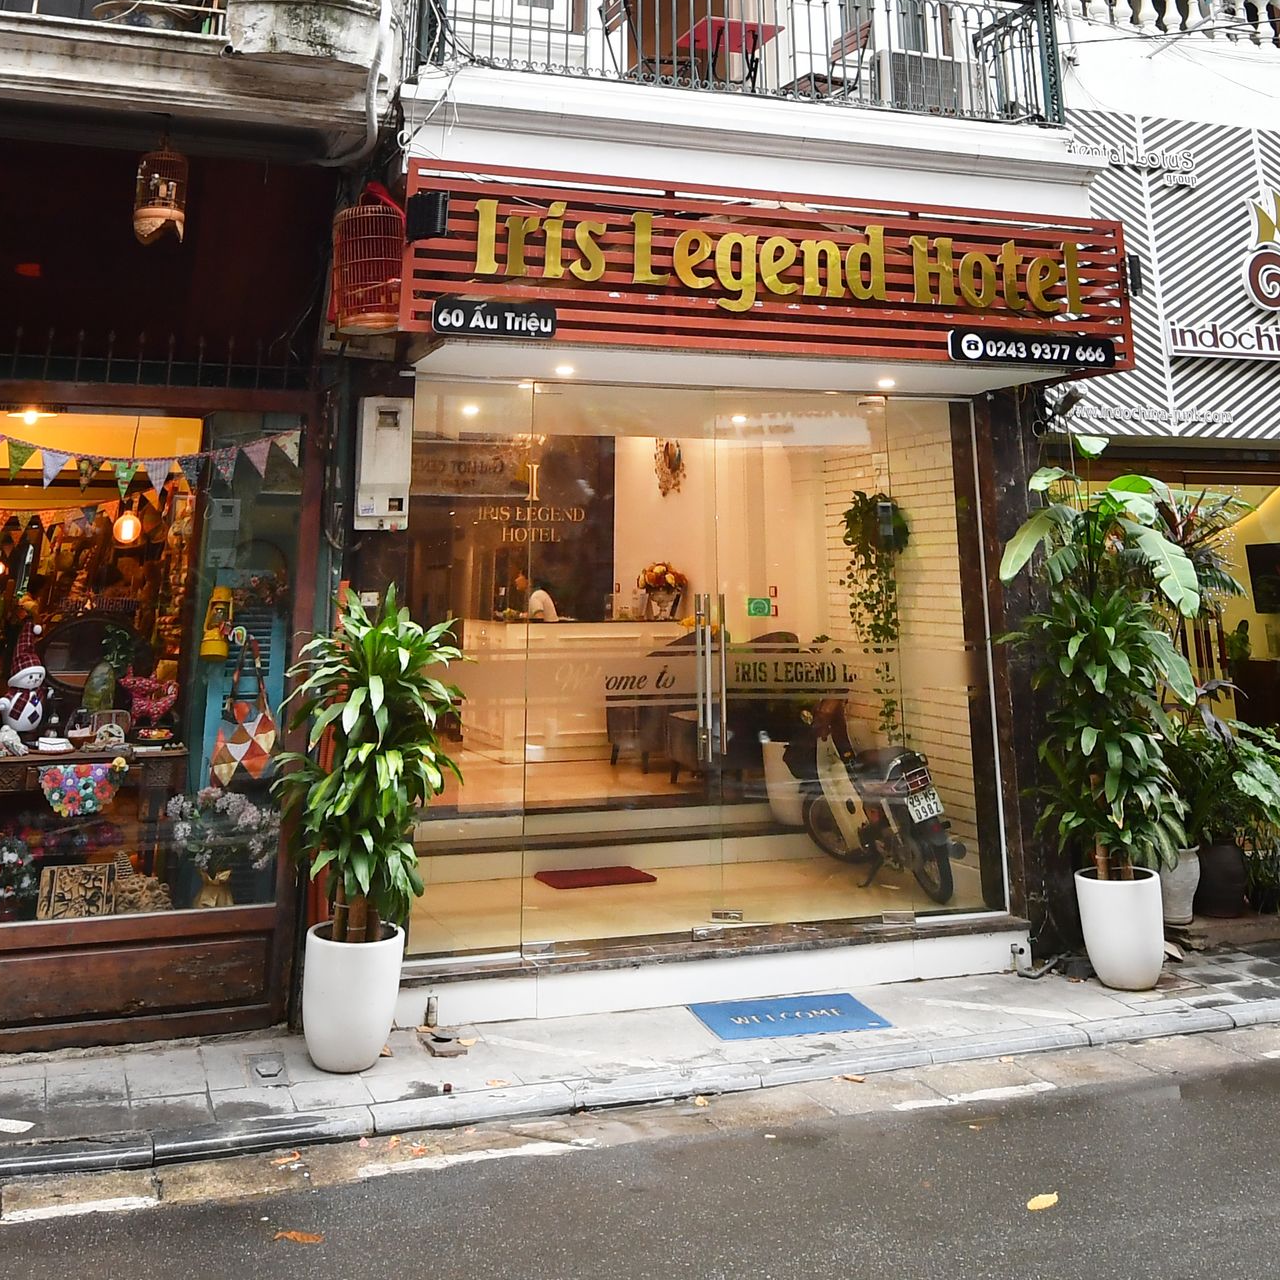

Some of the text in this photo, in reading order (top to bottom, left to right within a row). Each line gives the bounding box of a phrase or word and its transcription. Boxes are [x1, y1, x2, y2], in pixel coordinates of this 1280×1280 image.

[1165, 173, 1197, 186] group
[473, 199, 1086, 315] Iris Legend Hotel
[437, 302, 553, 337] 60 Ấu Triệu
[985, 339, 1106, 363] 0243 9377 666
[477, 505, 586, 523] IRIS LEGEND
[501, 527, 562, 543] HOTEL
[654, 664, 676, 690] to
[734, 661, 769, 684] IRIS
[773, 661, 838, 684] LEGEND
[729, 1007, 845, 1025] WELCOME
